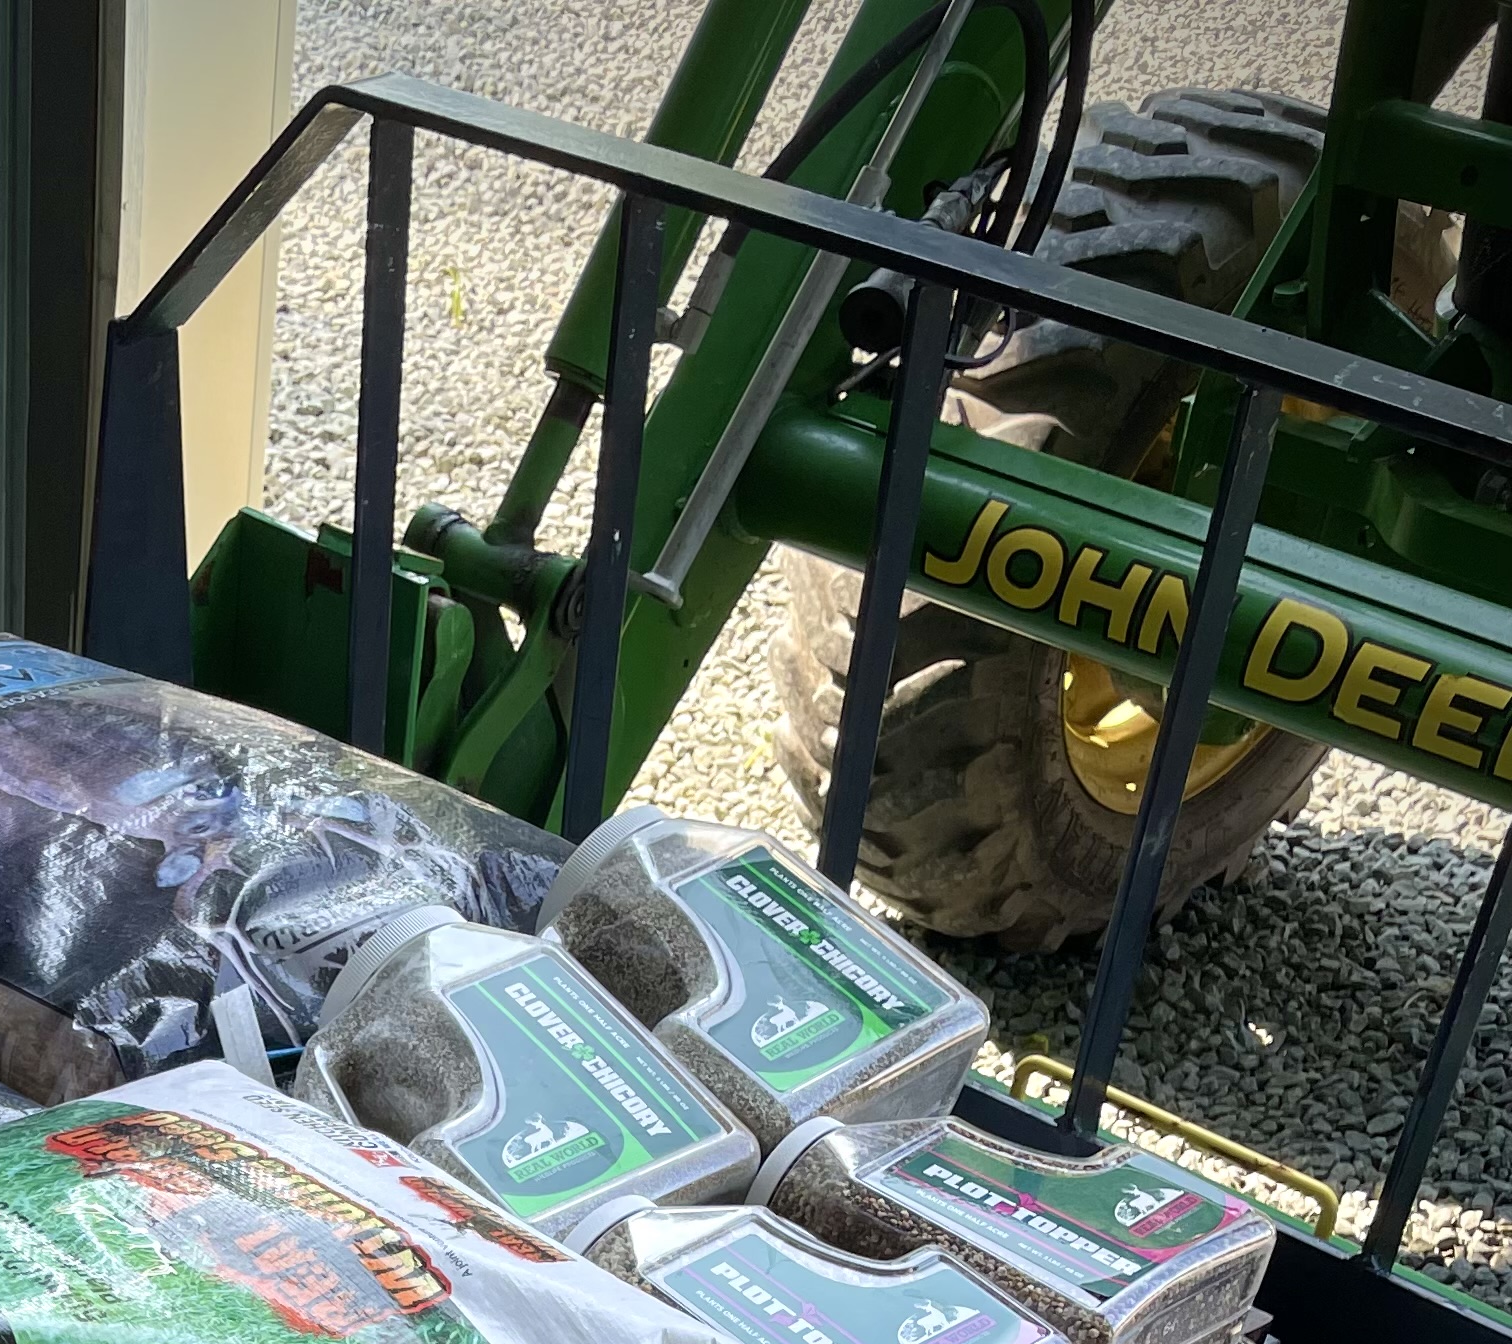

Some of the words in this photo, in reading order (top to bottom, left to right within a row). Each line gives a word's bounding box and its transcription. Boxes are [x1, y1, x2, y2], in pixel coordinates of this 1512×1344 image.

[1243, 598, 1512, 779] DEE
[725, 874, 810, 937] CLOVER
[809, 938, 905, 1011] CHICORY
[553, 975, 580, 1000] PLANTS
[504, 982, 585, 1051] CLOVER
[581, 1054, 672, 1137] CHICORY
[764, 1036, 801, 1058] REAL
[799, 1013, 840, 1043] WORLD
[514, 1156, 553, 1182] REAL
[550, 1134, 600, 1164] WORLD
[922, 1163, 1018, 1209] PLOT
[1009, 1206, 1142, 1277] TOPPER
[443, 1249, 467, 1272] joint
[694, 1289, 724, 1313] PLANTS
[722, 1308, 739, 1325] ONE
[737, 1320, 761, 1342] HALF
[709, 1261, 797, 1317] PLOT
